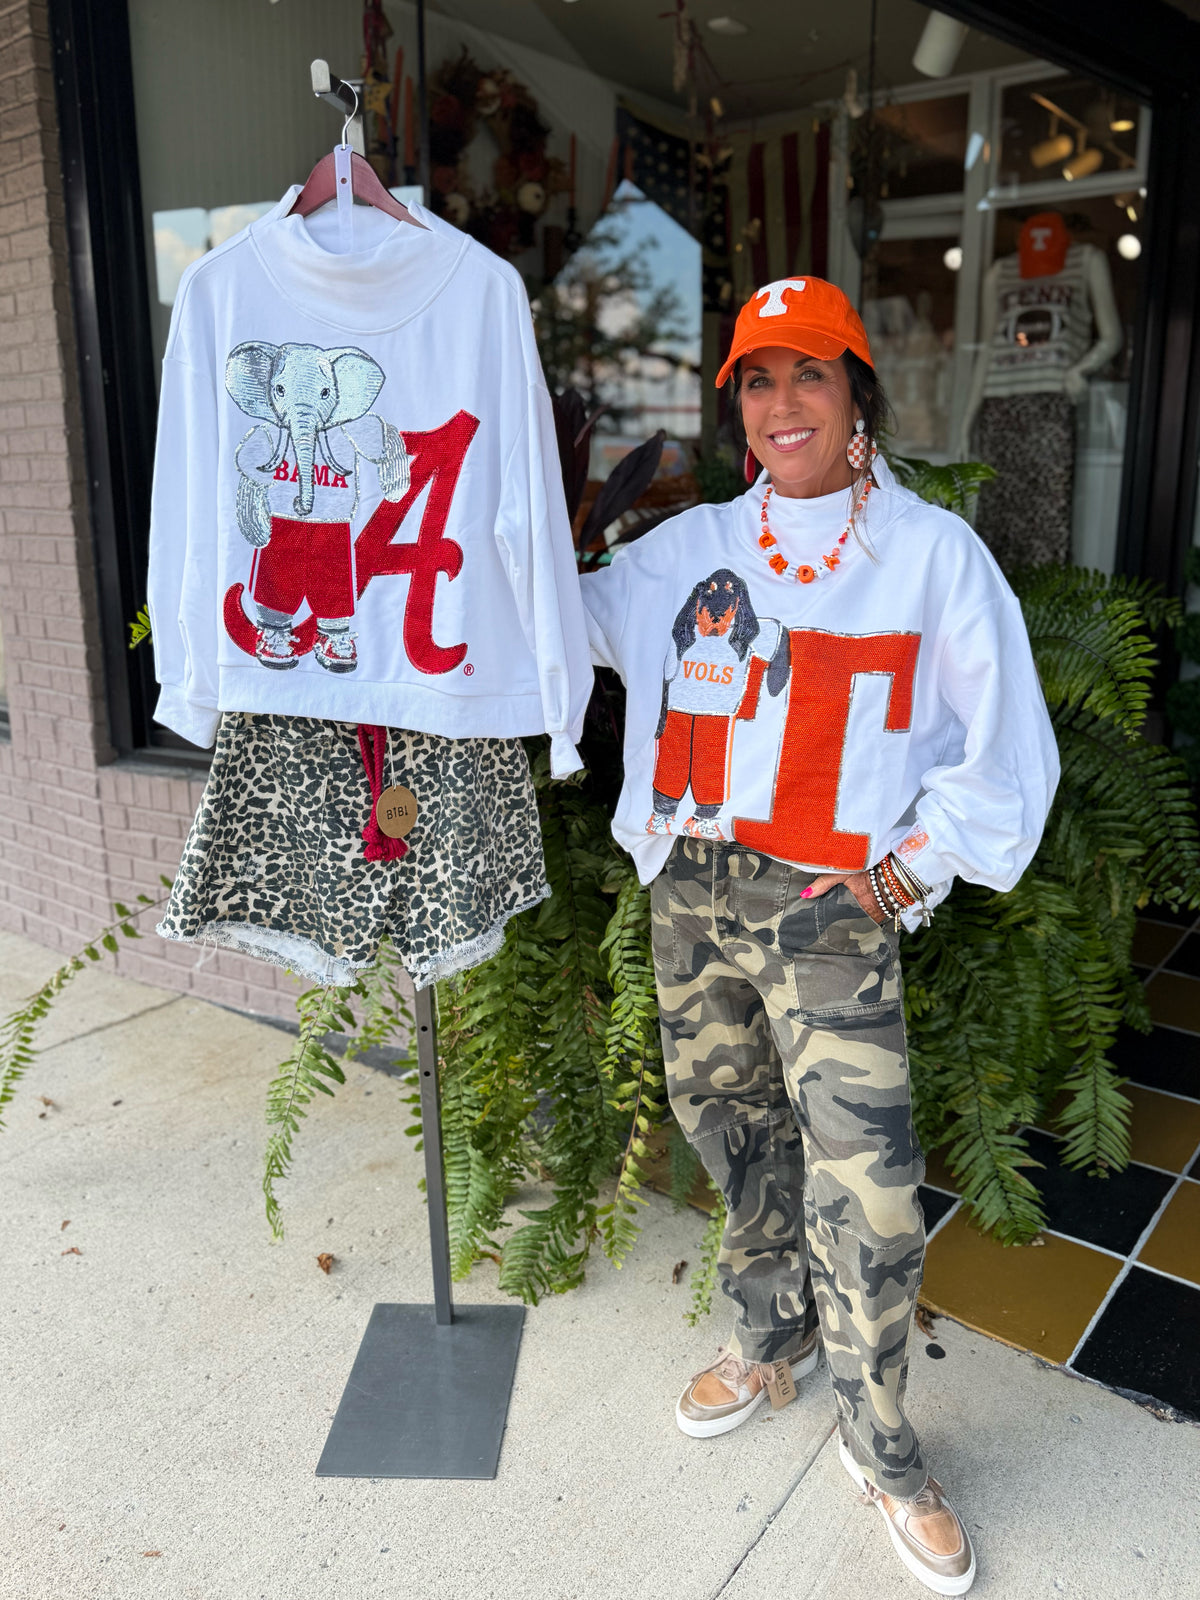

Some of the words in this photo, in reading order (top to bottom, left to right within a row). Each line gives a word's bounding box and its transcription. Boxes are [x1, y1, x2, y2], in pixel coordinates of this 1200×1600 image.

[1030, 228, 1052, 251] T
[756, 280, 806, 318] T
[683, 660, 734, 685] VOLS
[731, 627, 922, 871] T
